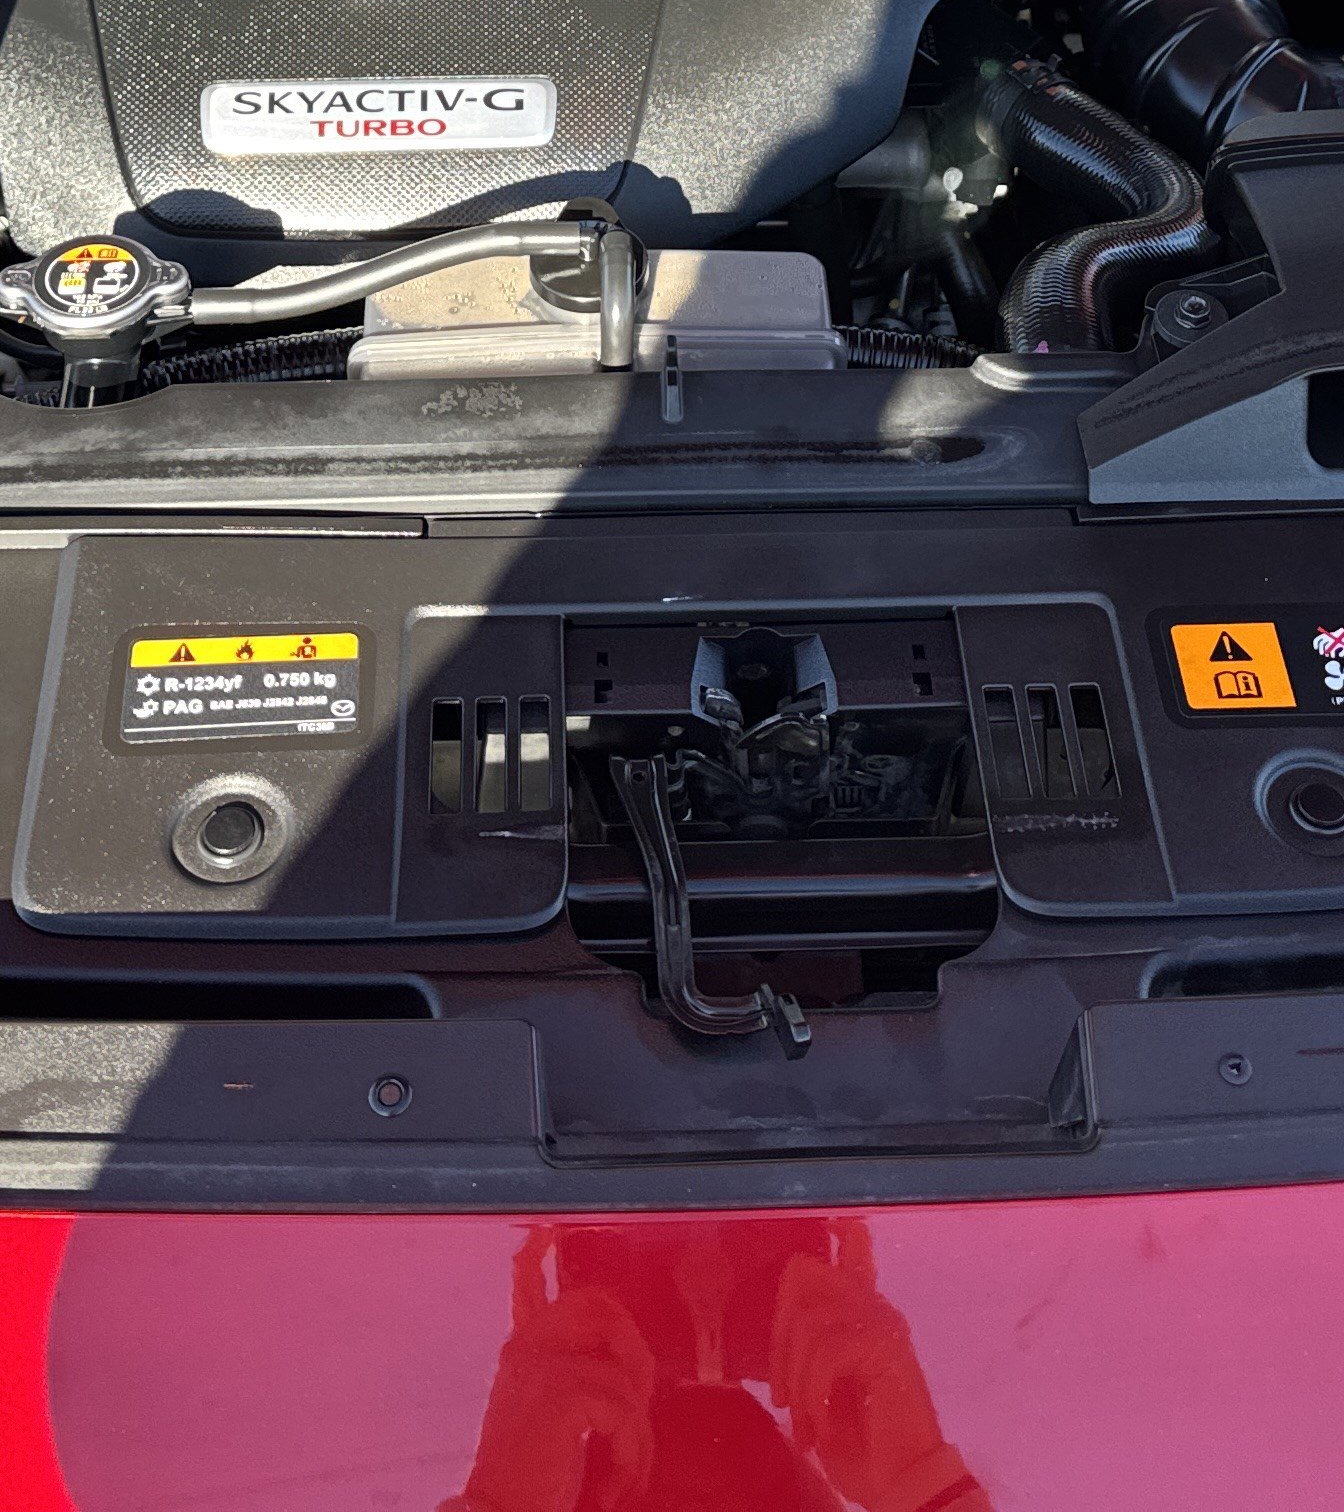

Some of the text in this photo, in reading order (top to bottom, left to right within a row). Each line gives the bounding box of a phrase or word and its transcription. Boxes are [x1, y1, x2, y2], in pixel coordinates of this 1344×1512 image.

[232, 88, 525, 116] SKYACTIV-G
[310, 118, 447, 138] TURBO
[164, 671, 337, 693] R-1234yf 0.750 kg
[162, 699, 203, 715] PAG
